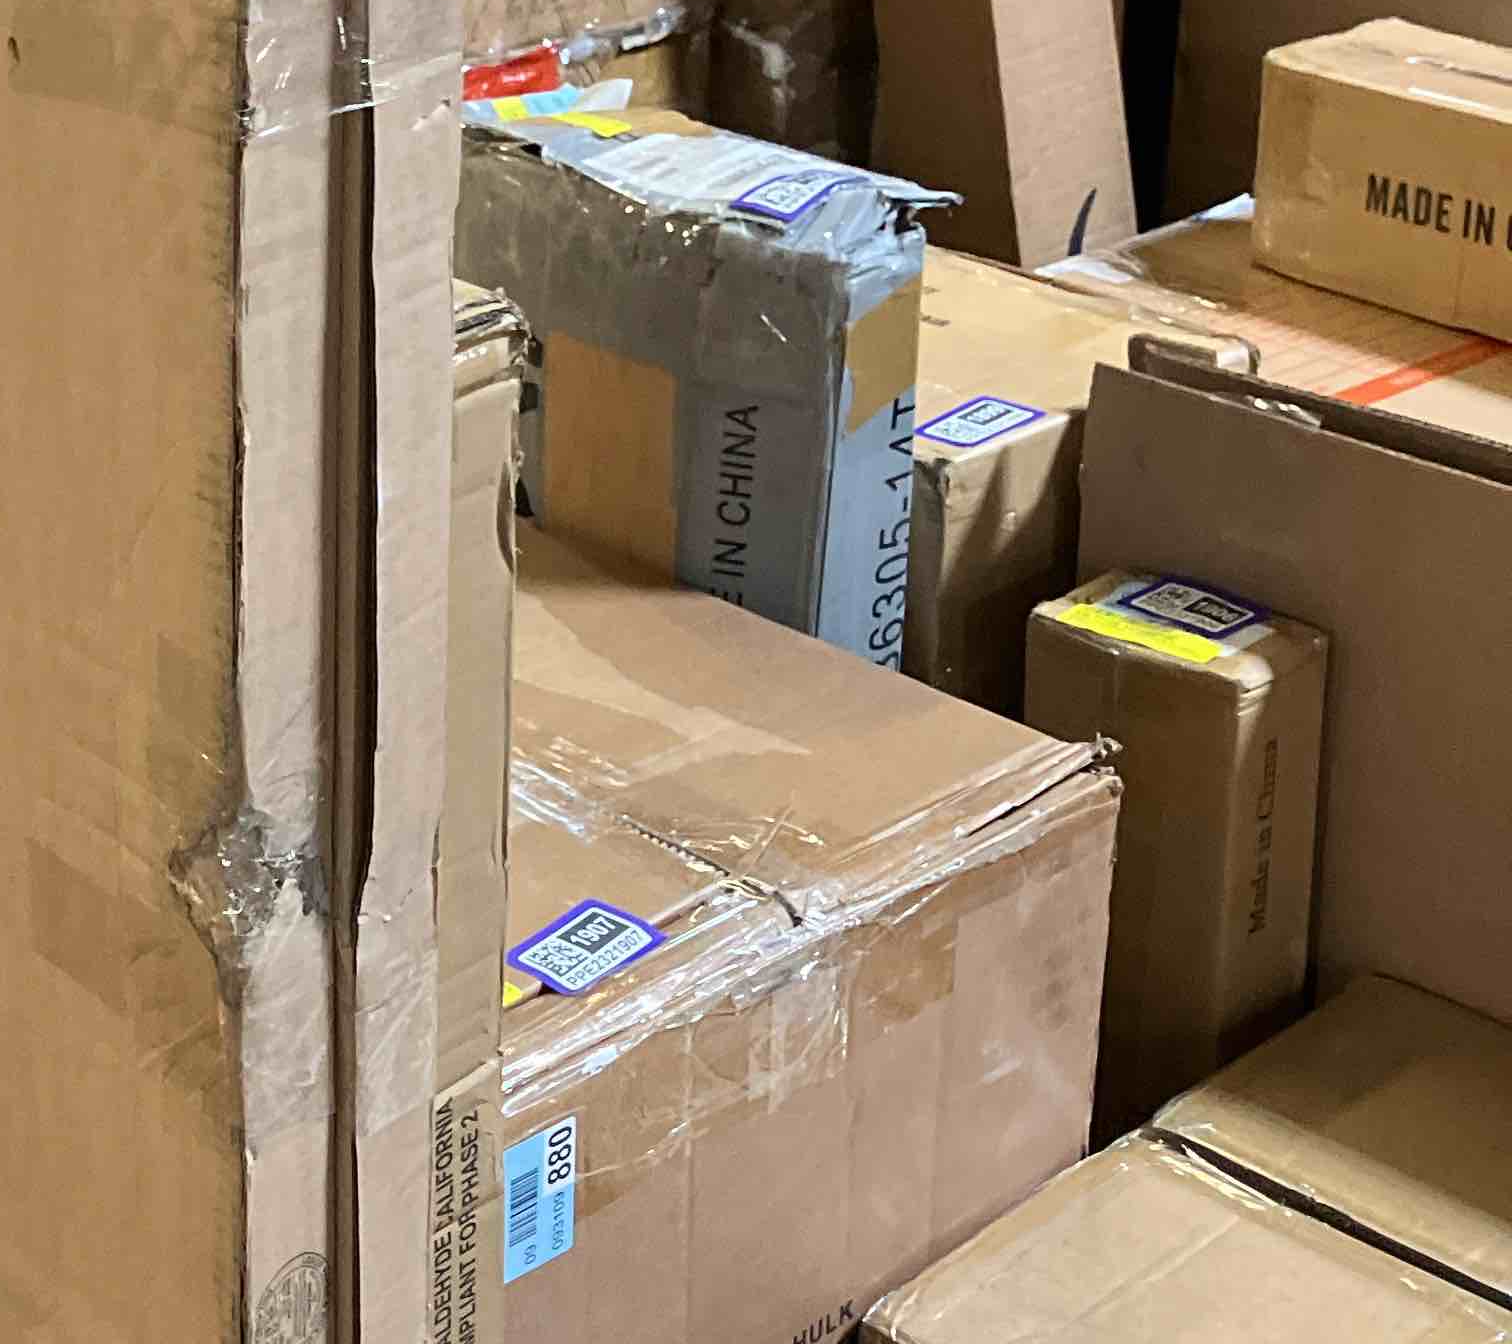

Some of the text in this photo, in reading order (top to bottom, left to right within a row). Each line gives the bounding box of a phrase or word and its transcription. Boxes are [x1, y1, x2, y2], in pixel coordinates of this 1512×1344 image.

[1366, 173, 1453, 233] MADE
[1462, 199, 1496, 246] IN
[716, 405, 759, 526] CHINA
[711, 538, 747, 578] IN
[566, 929, 641, 986] PPE2321907
[570, 915, 616, 946] 1907
[460, 1109, 479, 1128] 2
[461, 1128, 480, 1209] PHASE
[548, 1126, 572, 1185] 880
[458, 1213, 477, 1256] FOR
